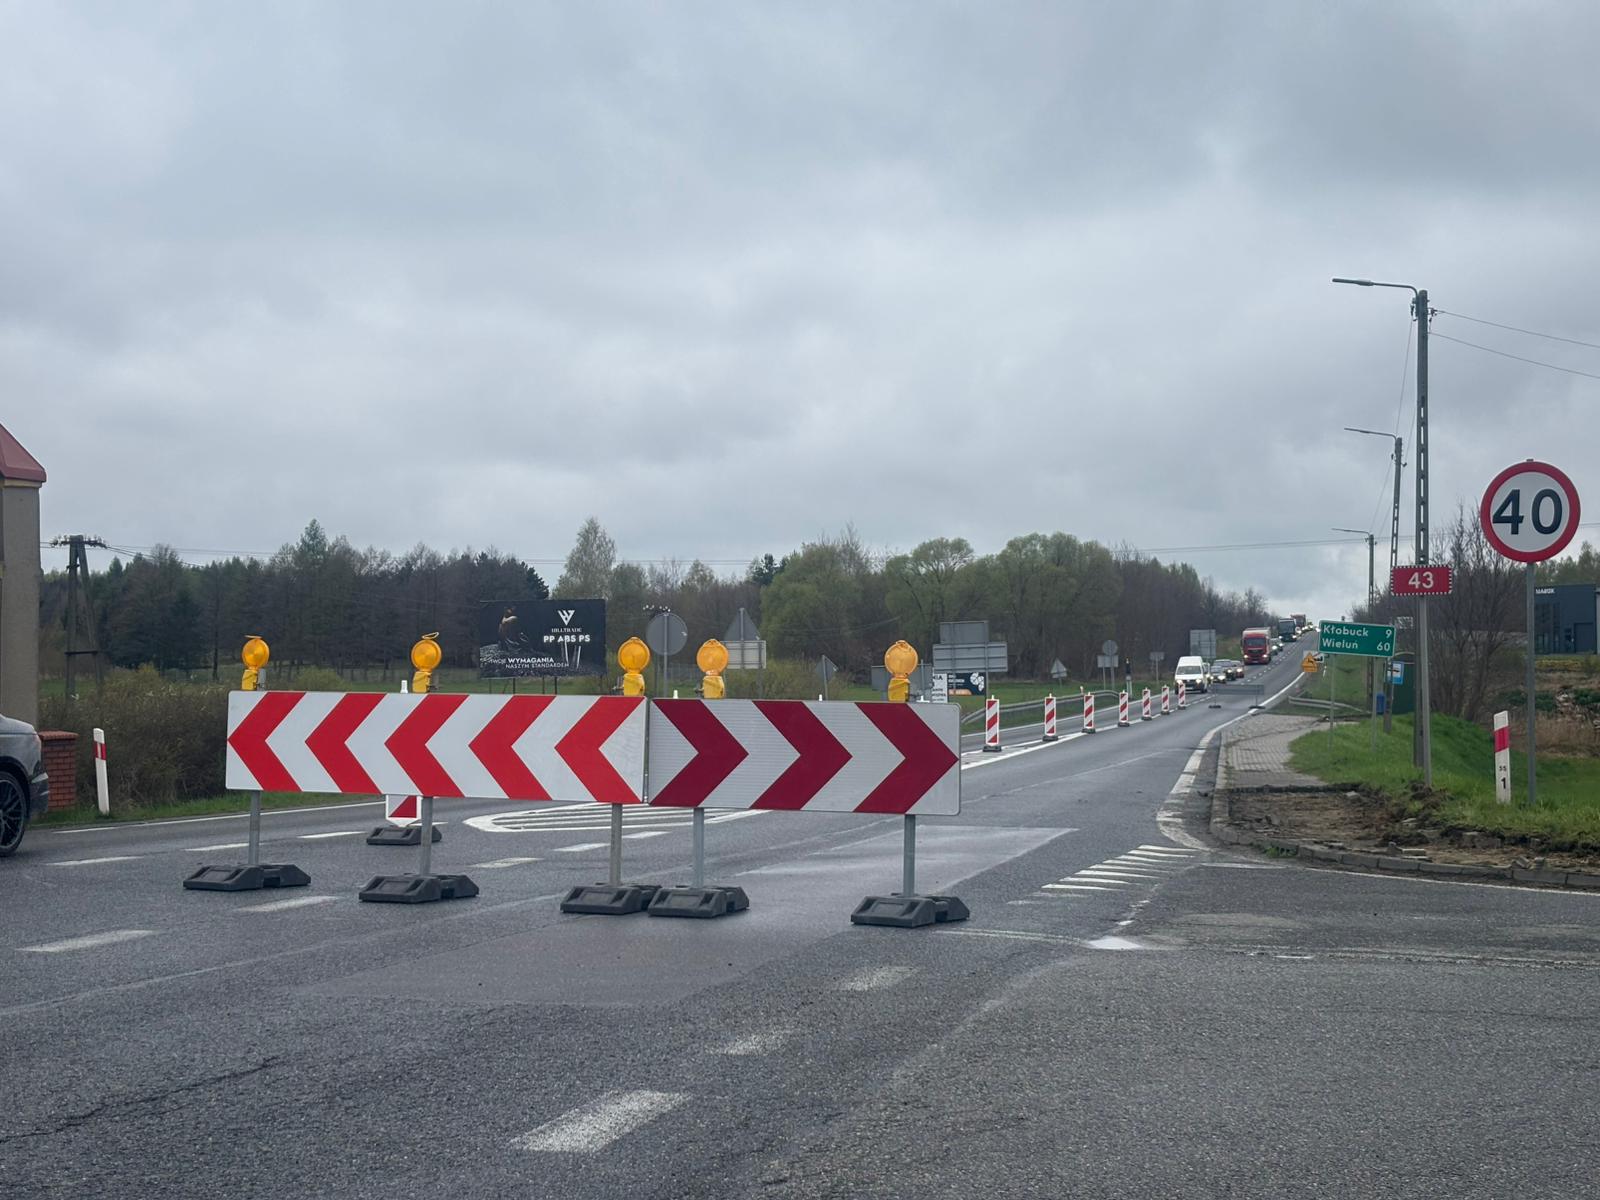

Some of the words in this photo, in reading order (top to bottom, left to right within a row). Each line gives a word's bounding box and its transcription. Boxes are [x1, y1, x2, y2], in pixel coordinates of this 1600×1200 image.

[1492, 488, 1563, 535] 40
[1408, 571, 1434, 589] 43
[543, 635, 555, 643] PP
[557, 634, 577, 643] ABS
[578, 634, 591, 642] PS
[1323, 624, 1369, 637] Kłobuck
[1385, 629, 1392, 639] 9
[1322, 638, 1359, 649] Wieluń
[1376, 641, 1391, 652] 60
[1500, 777, 1506, 790] 1
